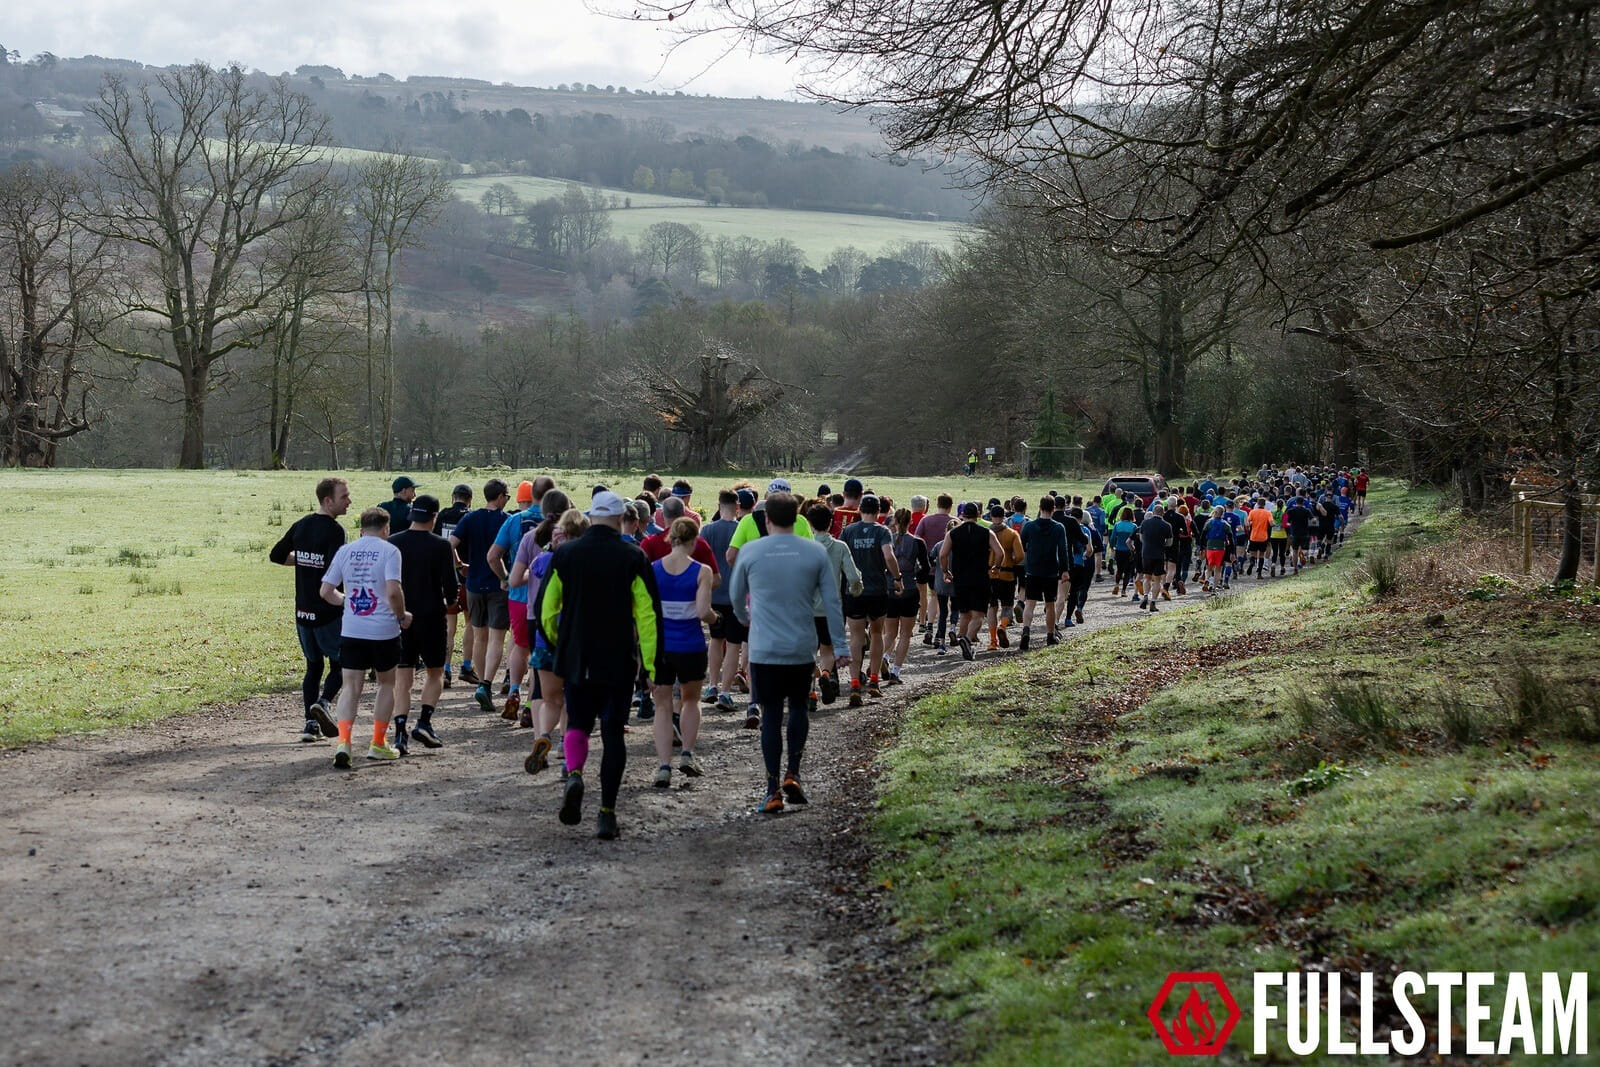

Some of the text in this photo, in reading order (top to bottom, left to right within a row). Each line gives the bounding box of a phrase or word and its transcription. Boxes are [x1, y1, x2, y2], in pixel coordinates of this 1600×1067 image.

[297, 550, 325, 561] BAD BOY
[350, 551, 379, 561] PEPPE
